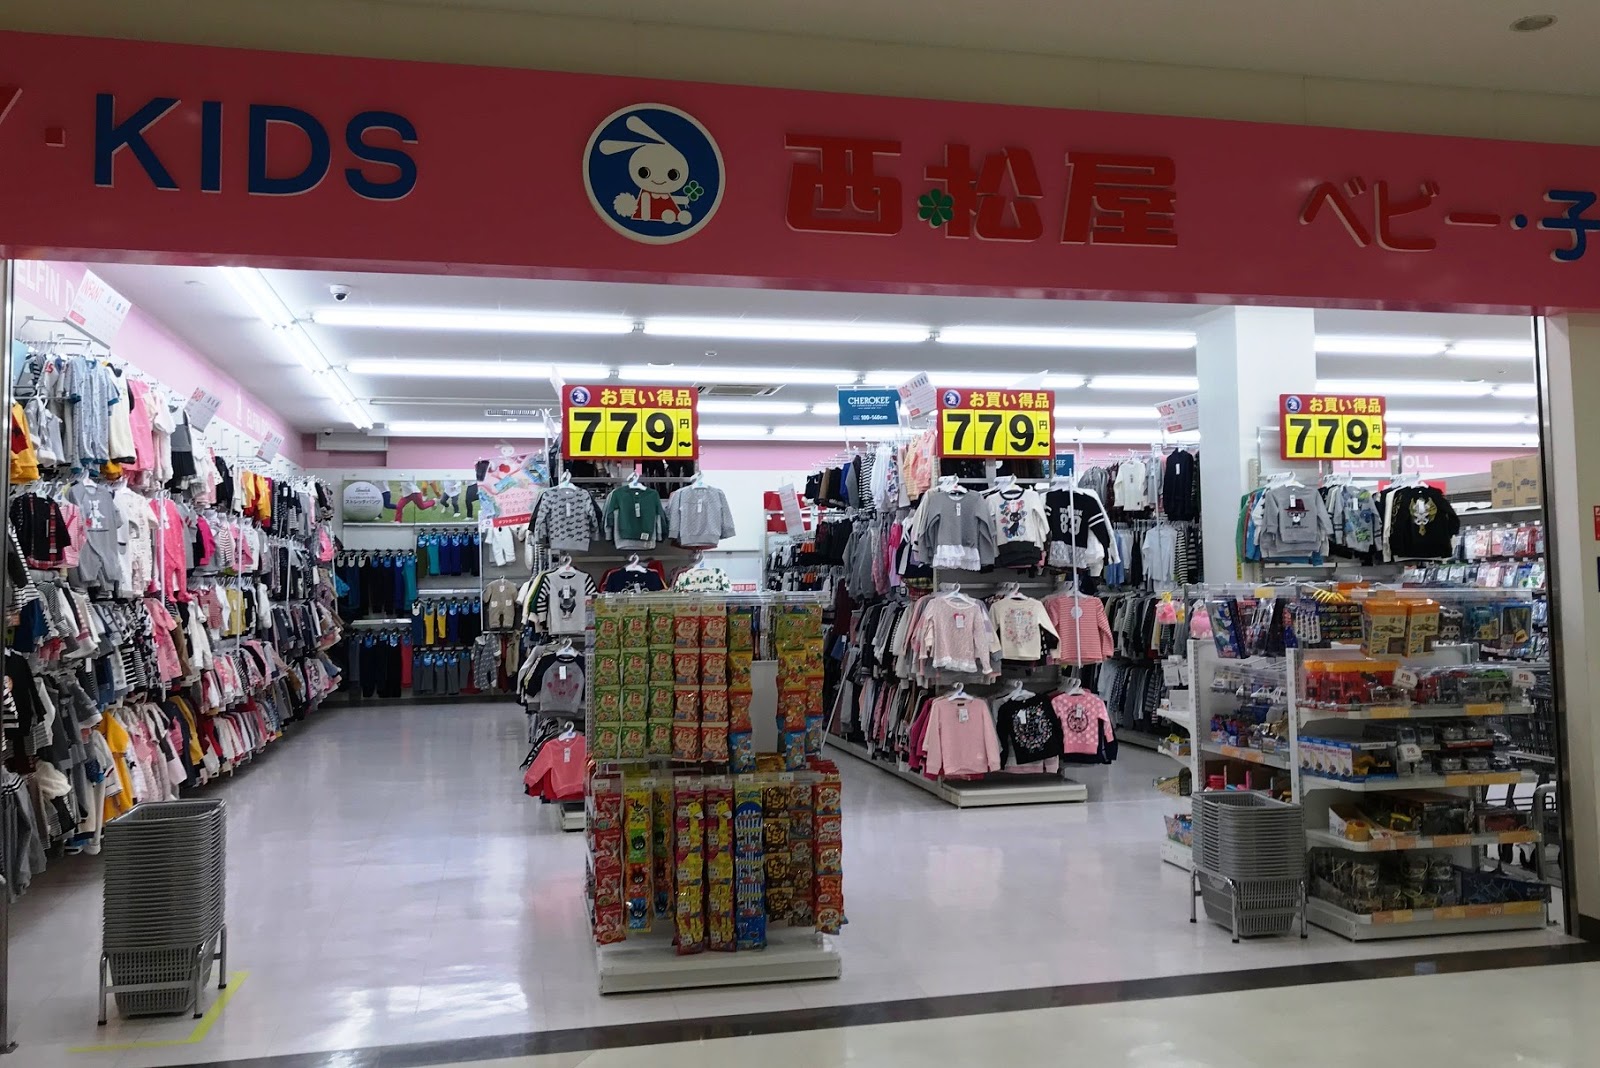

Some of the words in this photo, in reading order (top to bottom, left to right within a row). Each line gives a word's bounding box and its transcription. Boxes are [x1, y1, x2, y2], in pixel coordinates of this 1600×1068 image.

[94, 94, 419, 201] KIDS
[784, 133, 1179, 247] 西松屋
[600, 388, 692, 406] お買い得品
[847, 396, 890, 405] CHEROKEE
[969, 391, 1049, 408] お買い得品
[1309, 397, 1381, 413] お買い得品
